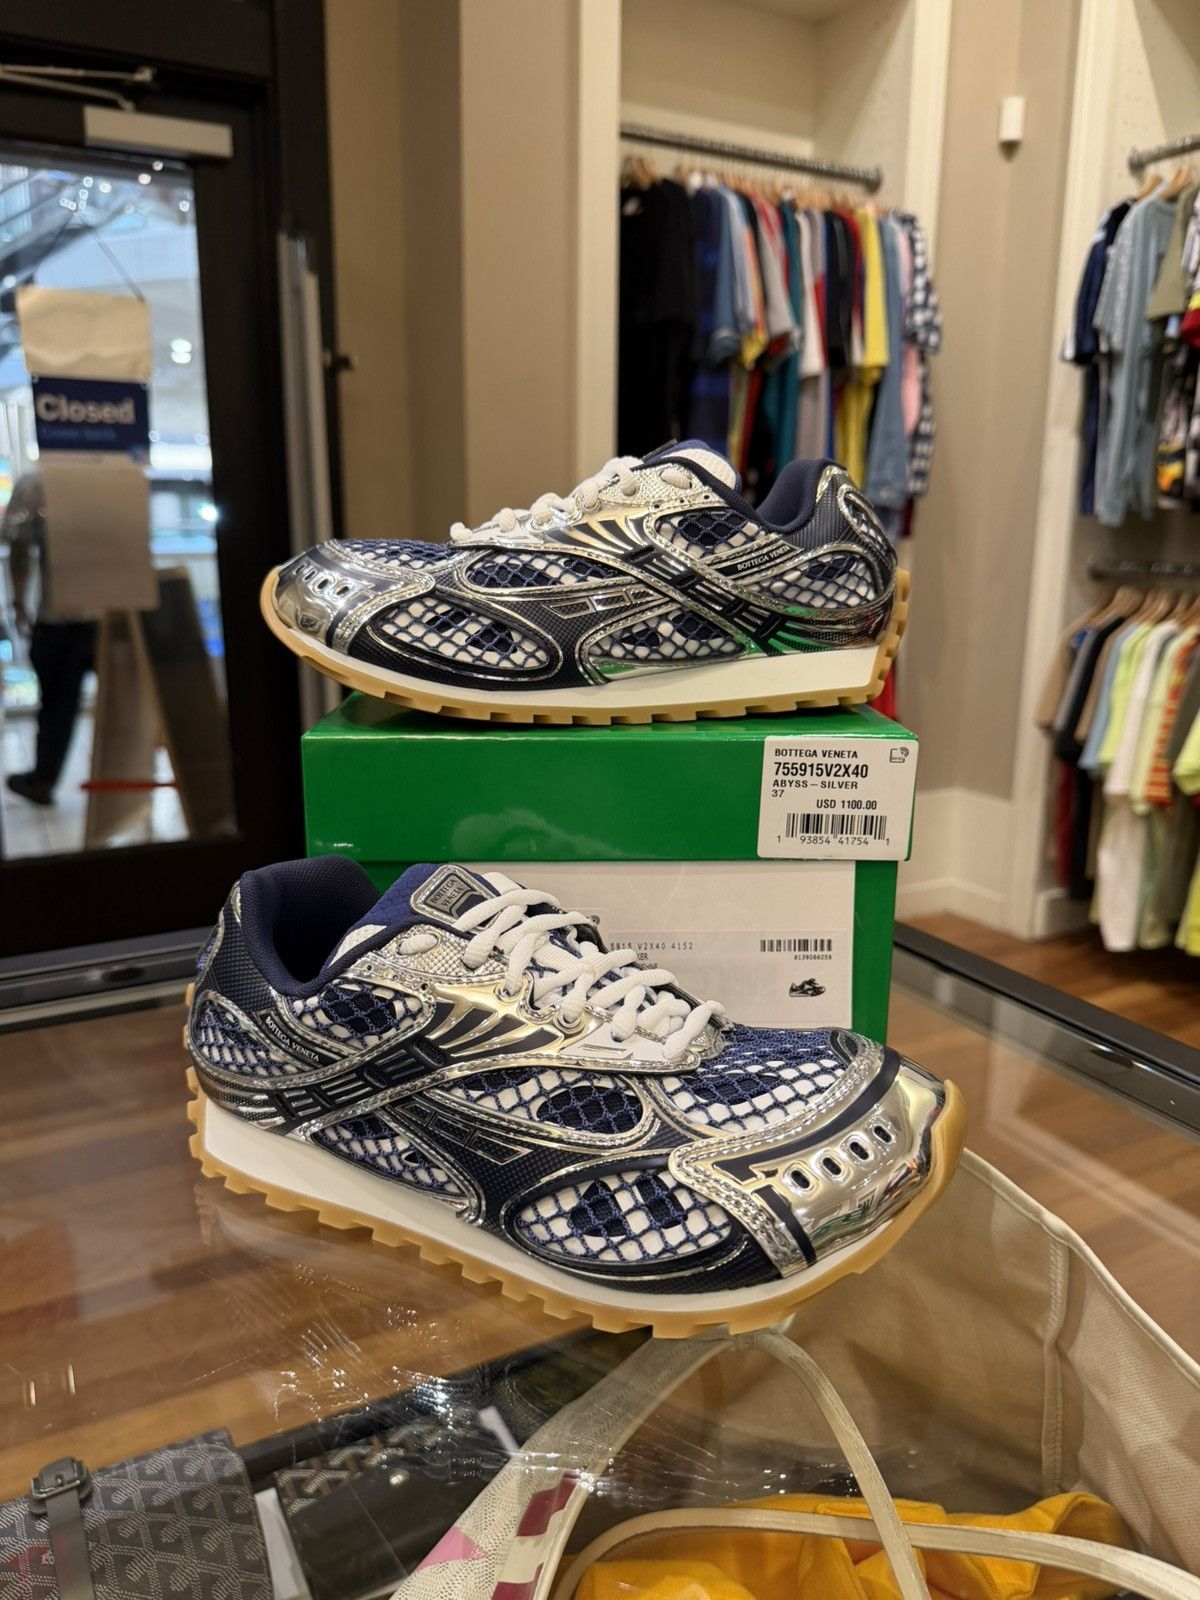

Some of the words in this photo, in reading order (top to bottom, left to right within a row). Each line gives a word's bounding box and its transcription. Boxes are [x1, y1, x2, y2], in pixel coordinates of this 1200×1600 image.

[36, 393, 136, 425] Closed
[737, 555, 769, 571] BOTTEGA
[768, 544, 791, 559] VENETA
[774, 748, 818, 758] BOTTEGA
[821, 749, 858, 759] VENETA
[773, 761, 869, 778] 755915V2X40
[772, 779, 808, 788] ABYSS
[820, 780, 858, 790] SILVER
[771, 789, 785, 798] 37
[816, 799, 837, 809] USD
[841, 800, 878, 810] 1100.00
[799, 835, 831, 845] 93854
[837, 836, 869, 846] 41754
[429, 878, 459, 904] BOTTEGA
[441, 886, 465, 908] VENETA
[637, 942, 667, 951] V2X40
[671, 942, 694, 951] 4152
[265, 1015, 291, 1046] BOTTEGA
[292, 1042, 320, 1062] VENETA
